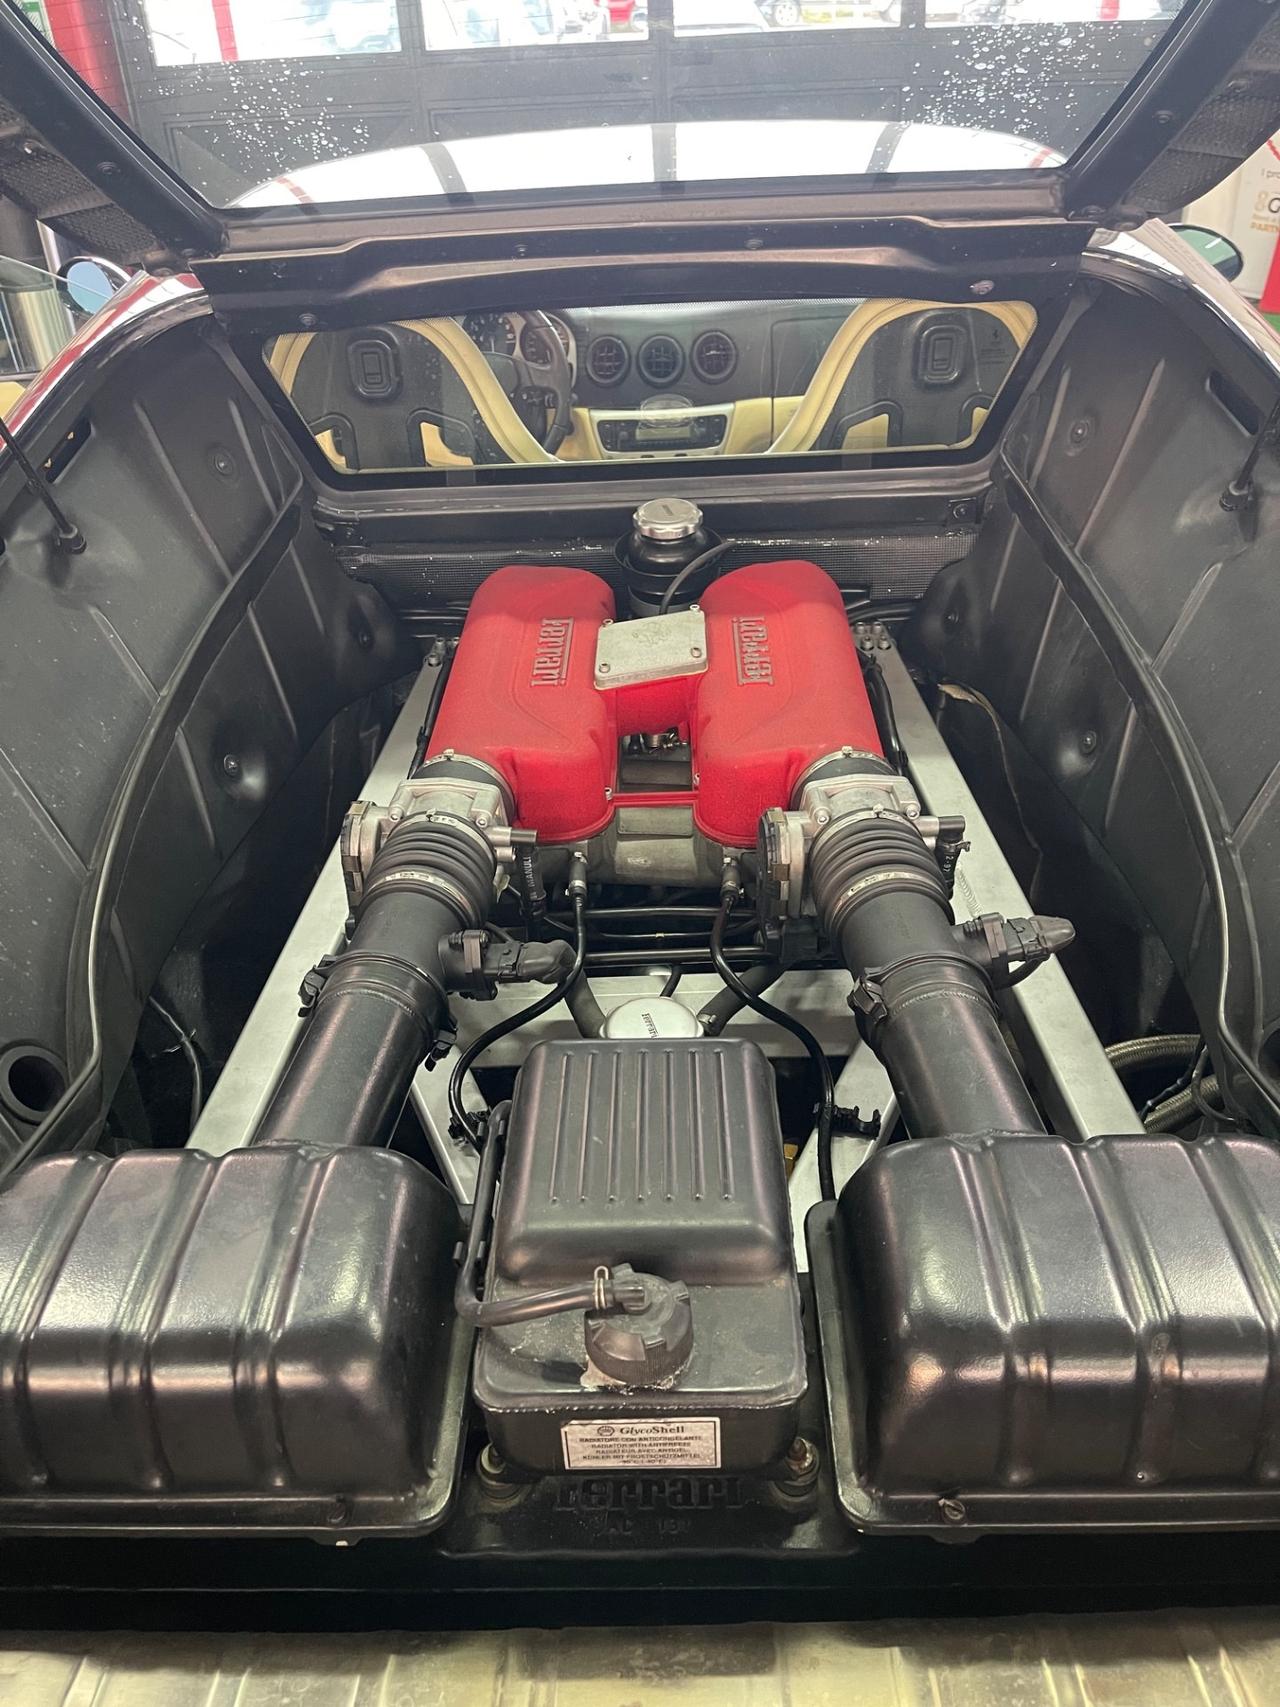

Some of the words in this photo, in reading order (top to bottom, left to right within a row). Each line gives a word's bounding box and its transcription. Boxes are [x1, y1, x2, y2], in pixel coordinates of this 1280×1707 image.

[530, 617, 574, 687] Ferrari
[731, 616, 774, 686] Ferrari
[620, 1426, 685, 1435] GlycoShell
